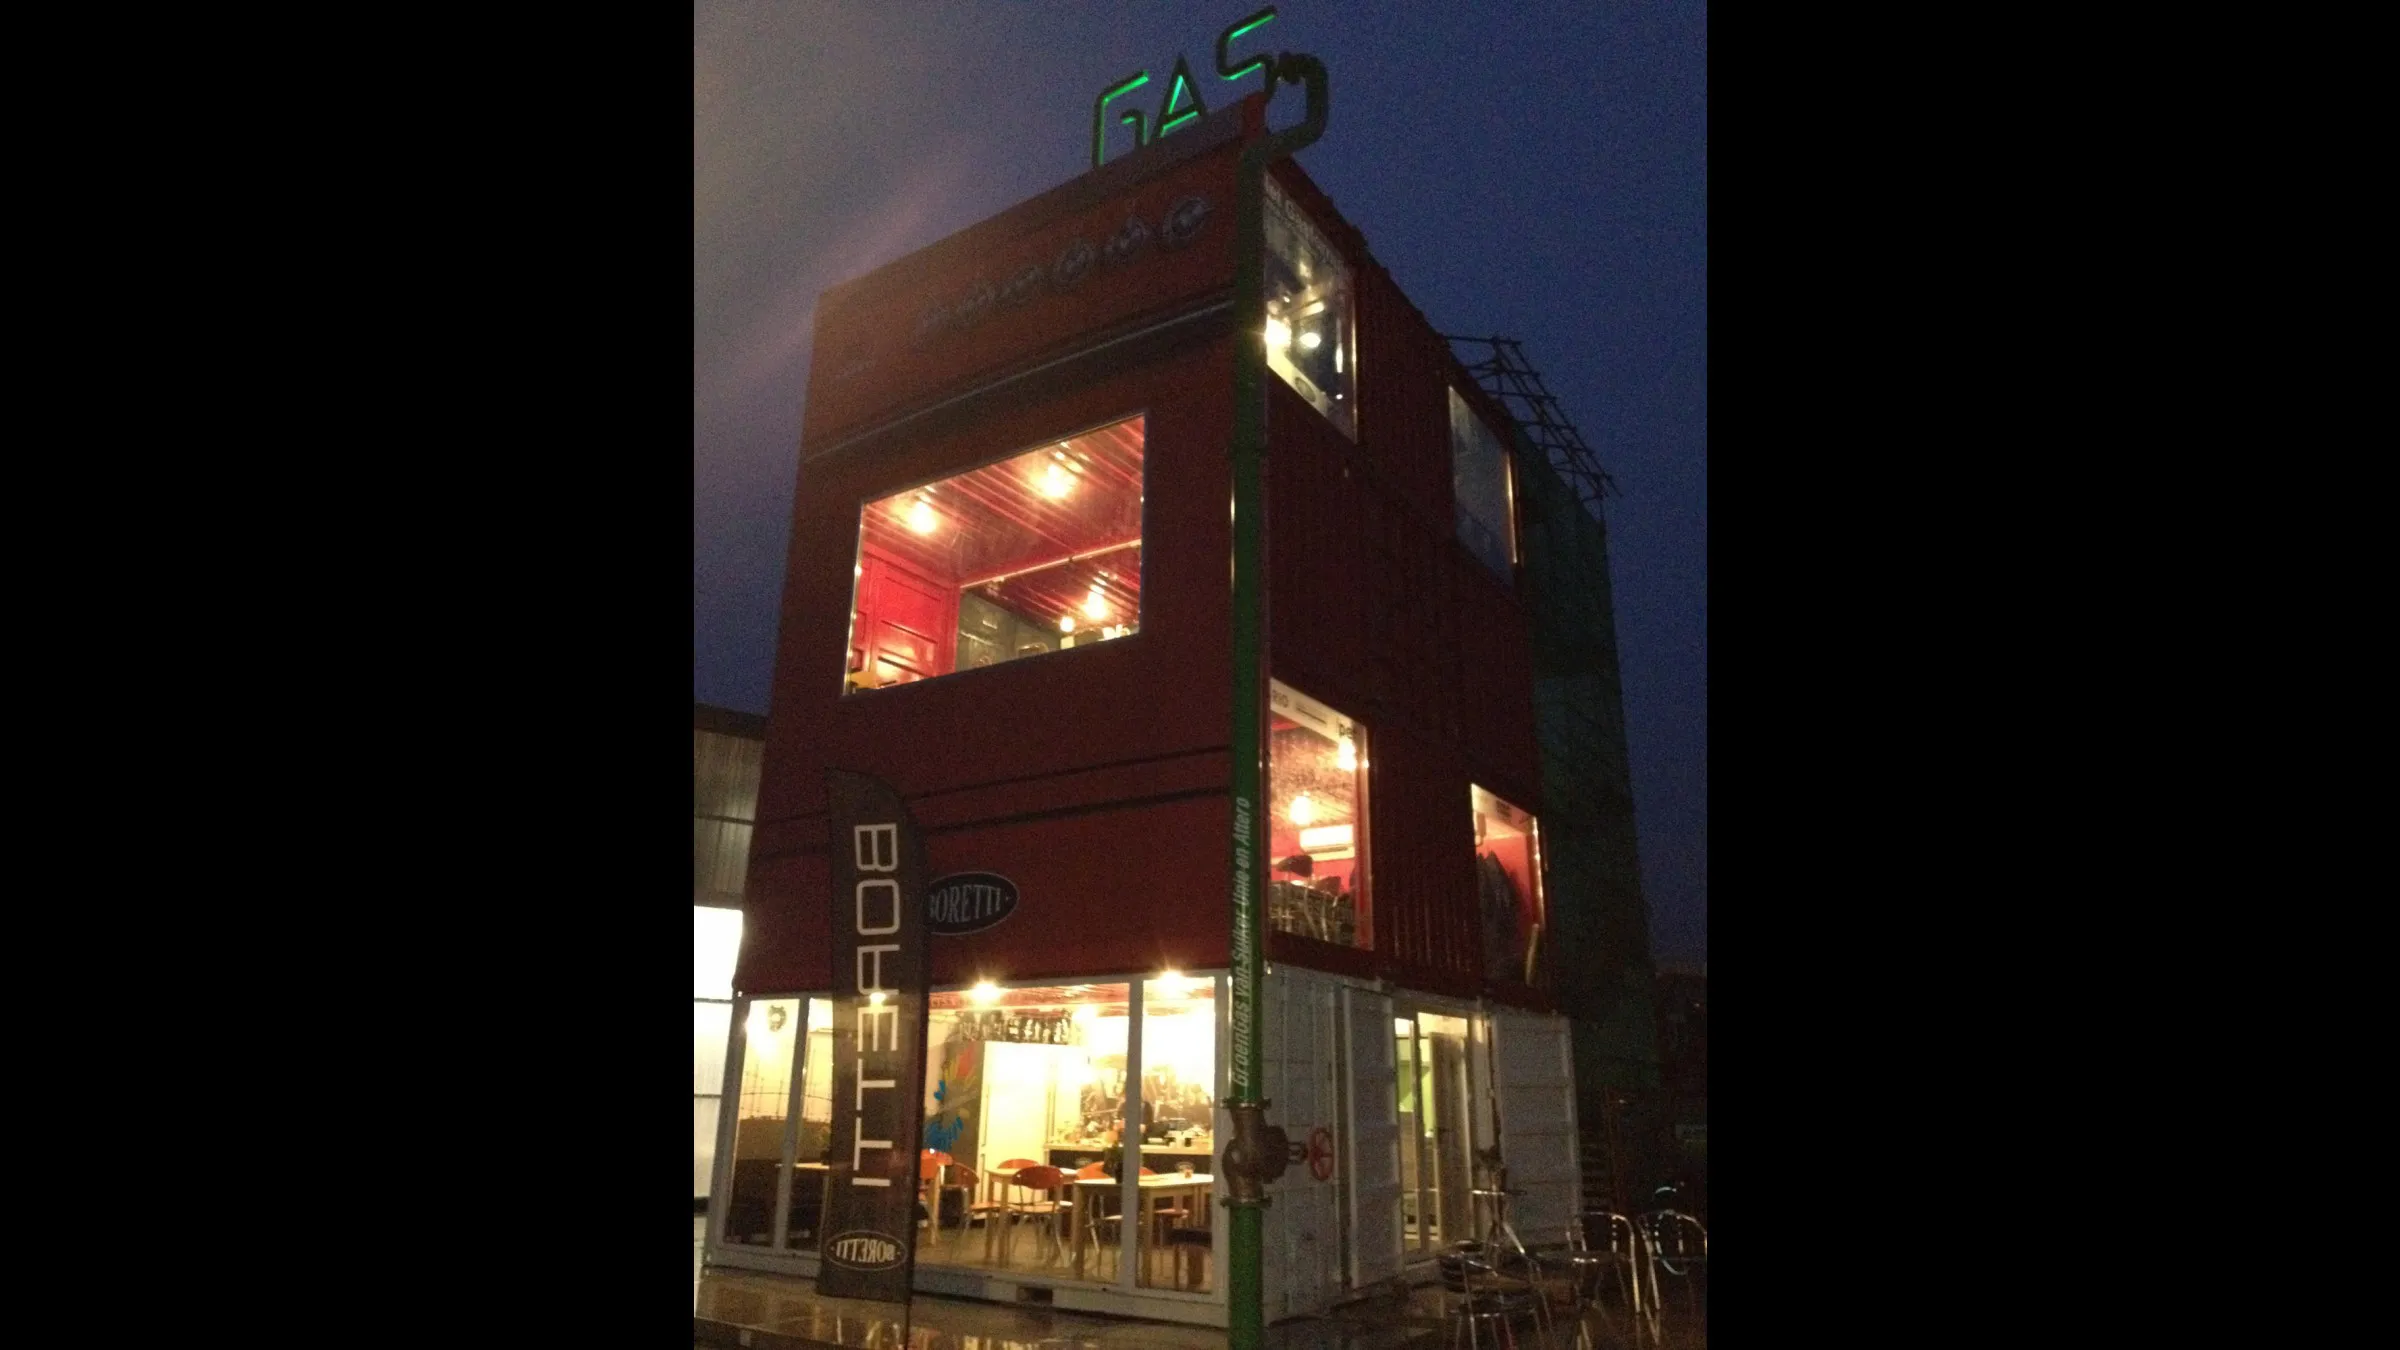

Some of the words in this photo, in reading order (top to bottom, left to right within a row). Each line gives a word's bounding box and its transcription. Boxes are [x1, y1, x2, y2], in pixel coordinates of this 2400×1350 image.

[1092, 5, 1277, 168] GAS
[1232, 796, 1251, 847] Attero
[1235, 847, 1250, 869] en
[1232, 870, 1250, 906] Unie
[1231, 909, 1251, 963] Suiker
[1234, 966, 1250, 997] van
